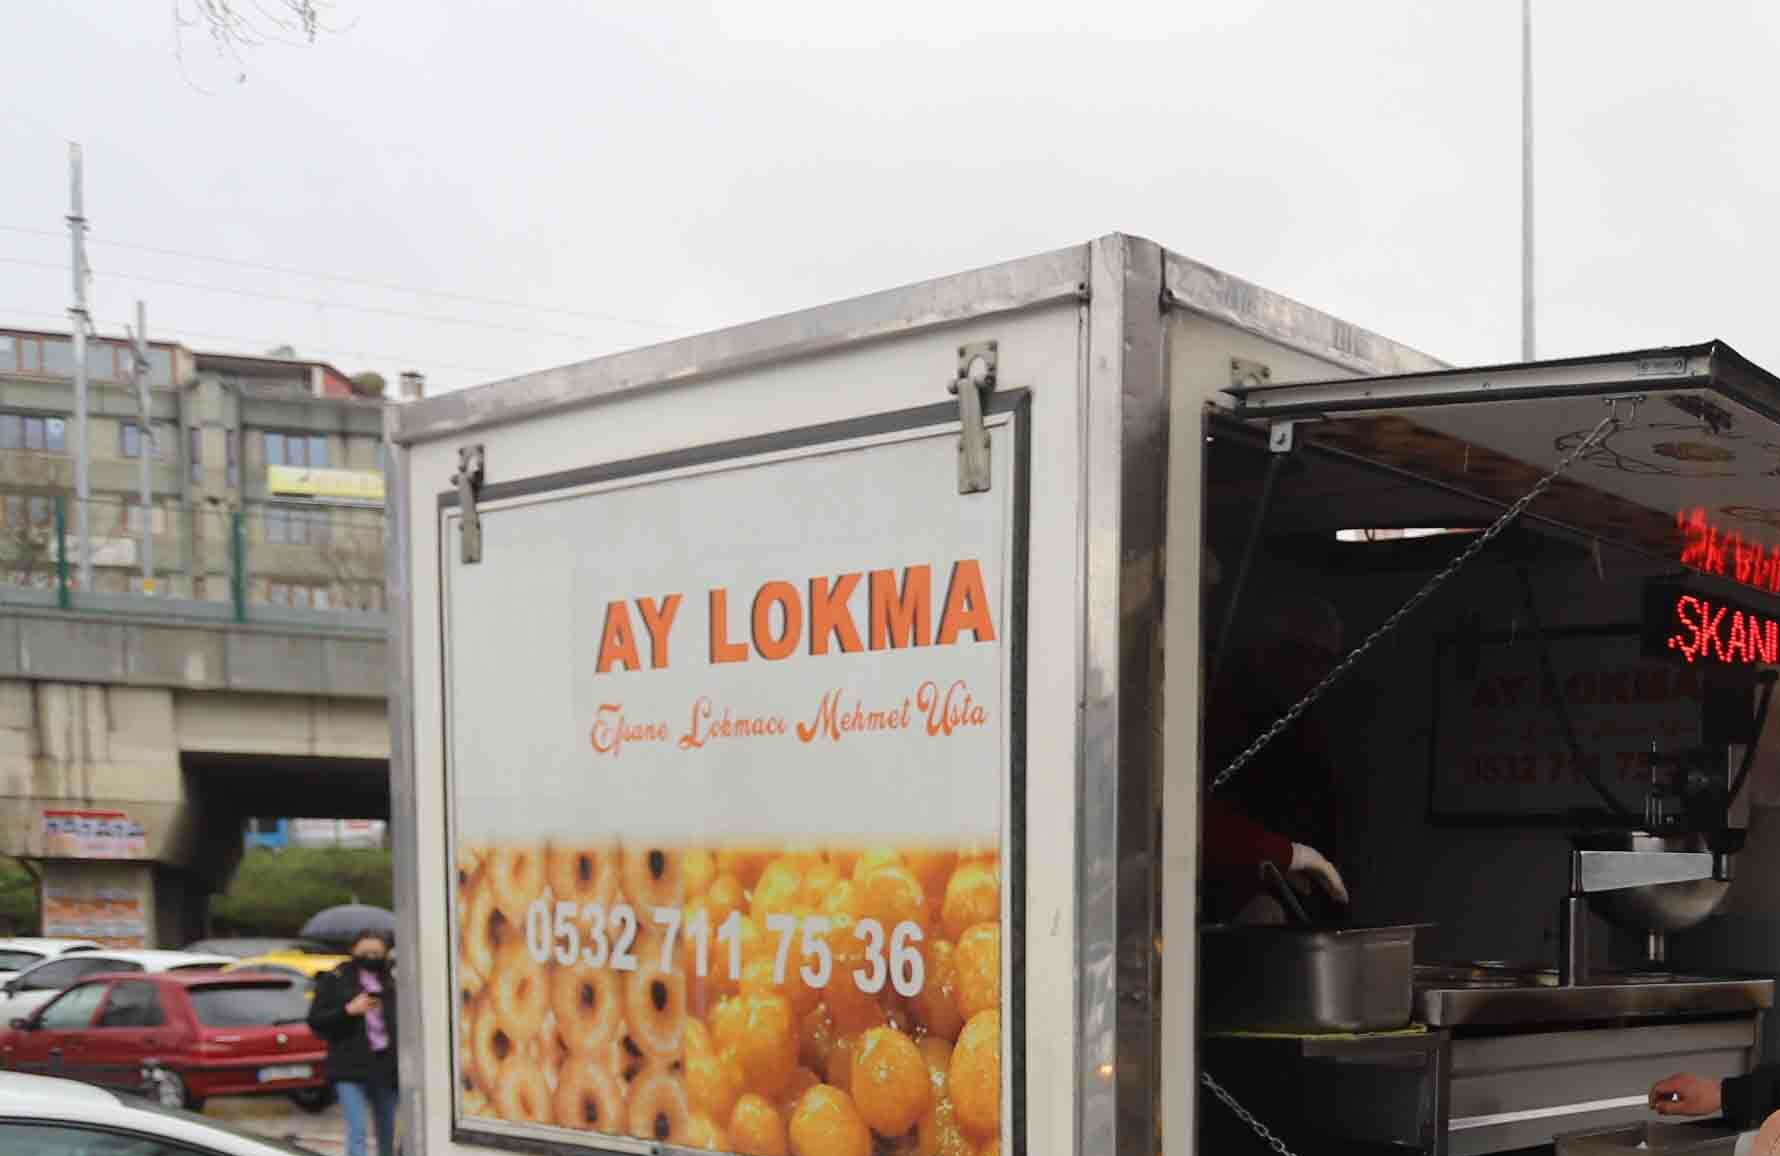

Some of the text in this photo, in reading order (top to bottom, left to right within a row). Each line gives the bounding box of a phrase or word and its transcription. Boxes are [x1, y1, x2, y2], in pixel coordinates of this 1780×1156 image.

[594, 558, 997, 674] AY LOKMA
[795, 687, 912, 743] Mehmet
[916, 679, 991, 737] Usta
[526, 896, 926, 998] 0532 711 75 36
